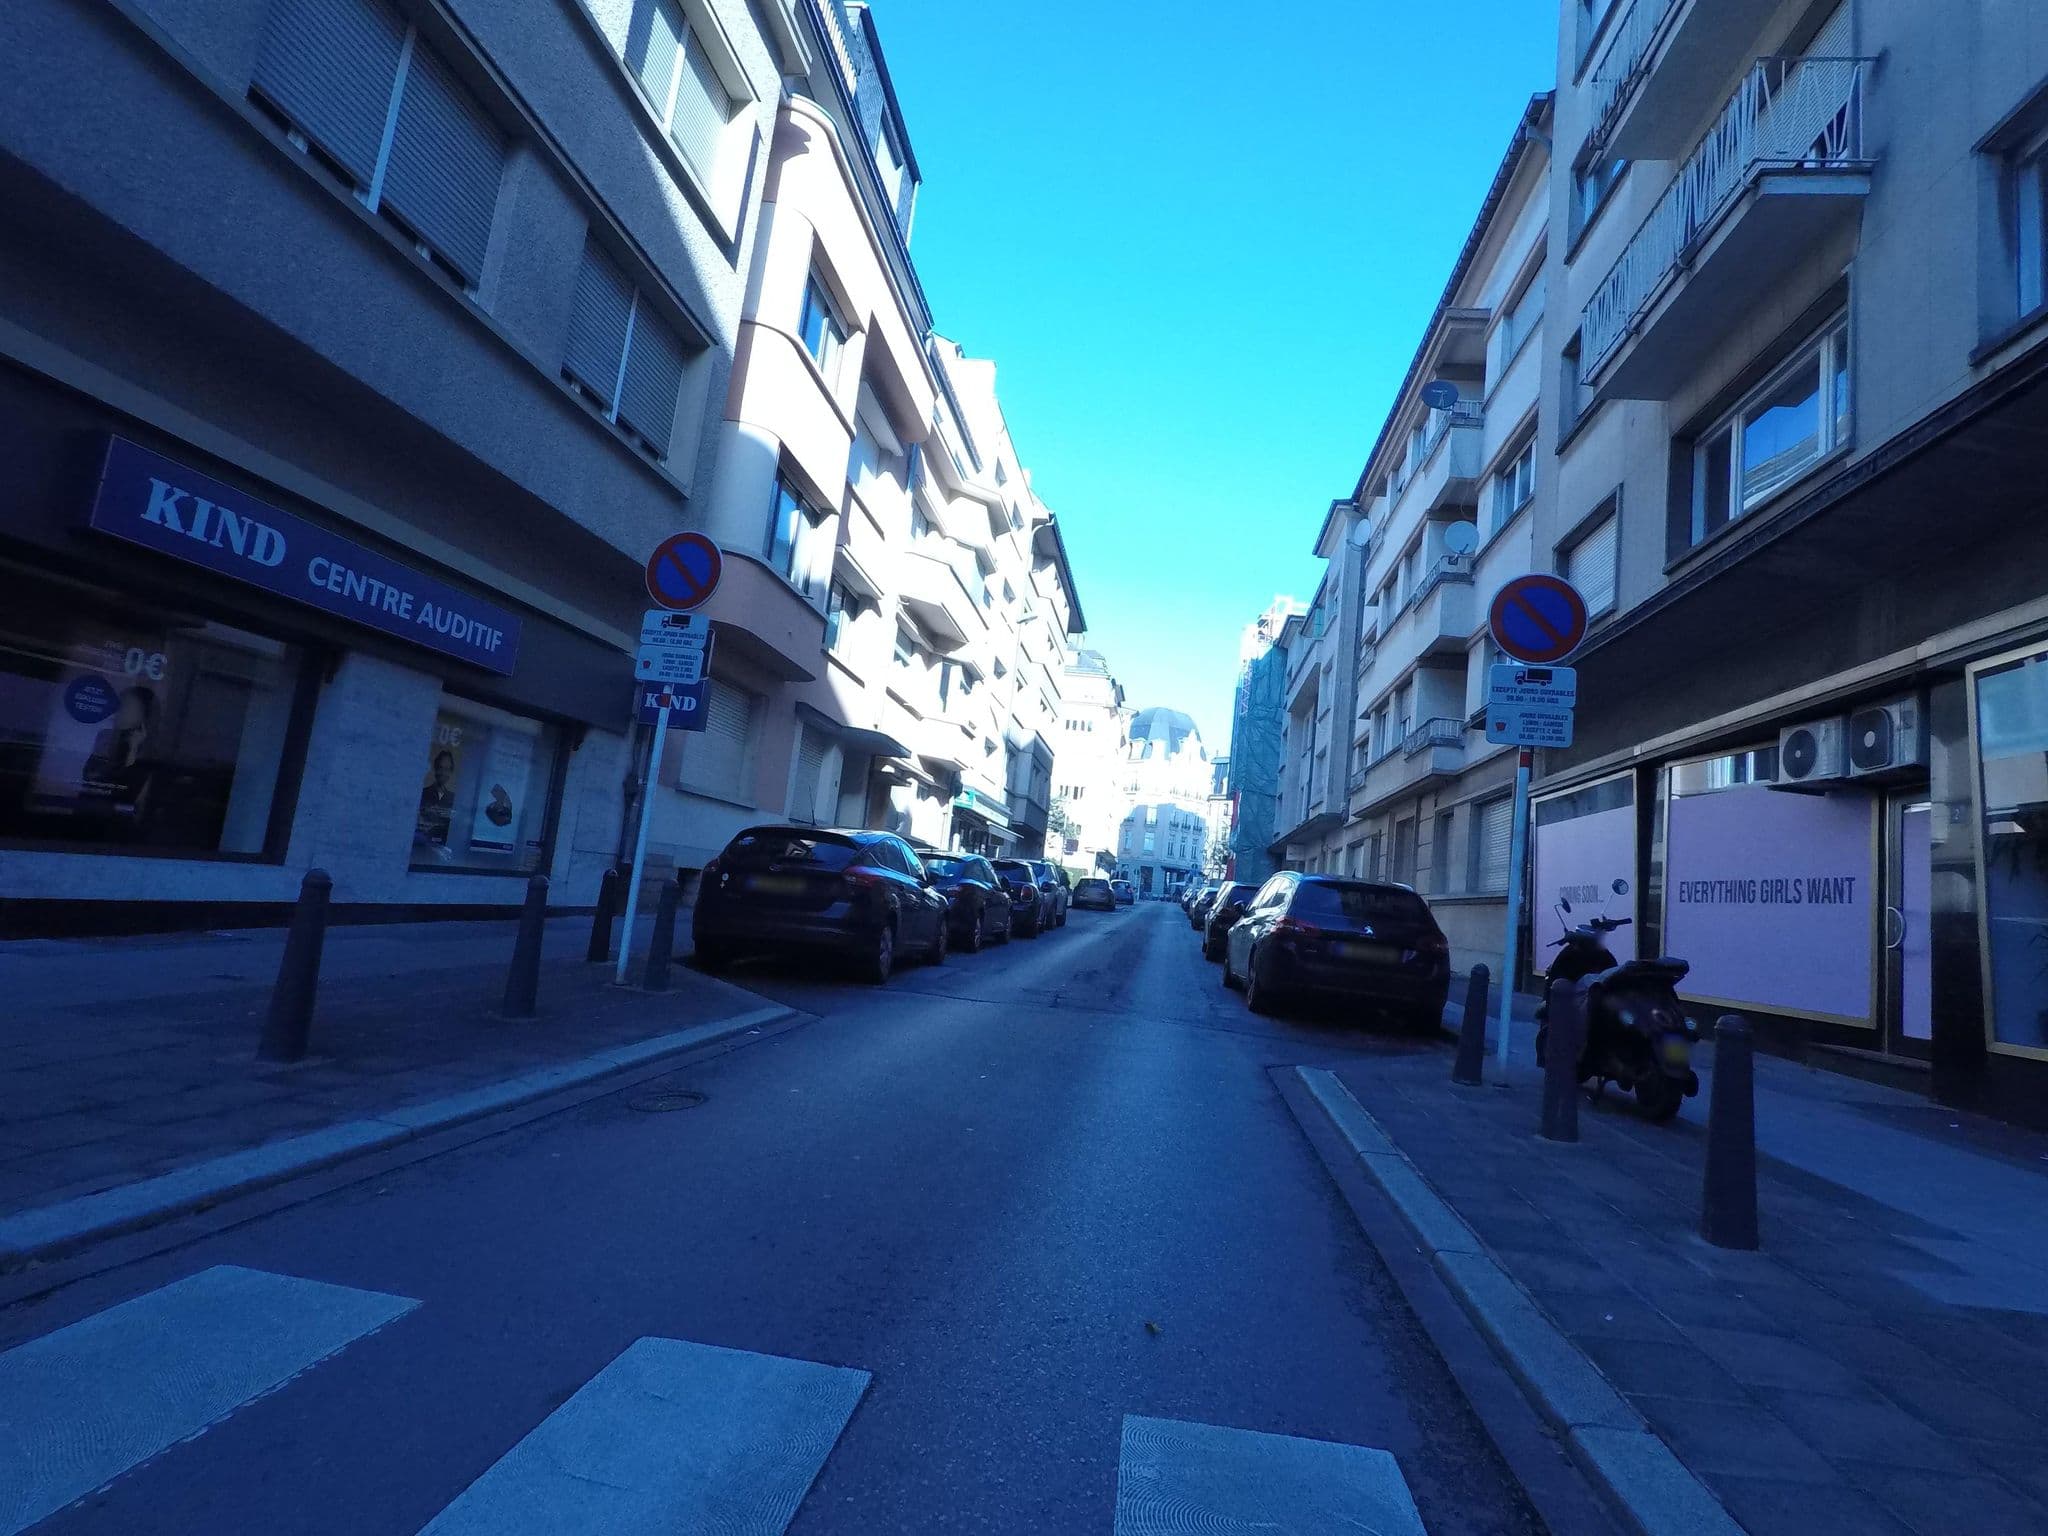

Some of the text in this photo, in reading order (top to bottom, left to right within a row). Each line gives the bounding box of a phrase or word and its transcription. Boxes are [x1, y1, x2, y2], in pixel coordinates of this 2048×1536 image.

[139, 477, 287, 567] KIND
[308, 556, 502, 652] CENTRE AUDITIF
[644, 692, 697, 711] KND
[1679, 877, 1856, 904] EVERYTHING GIRLS WANT
